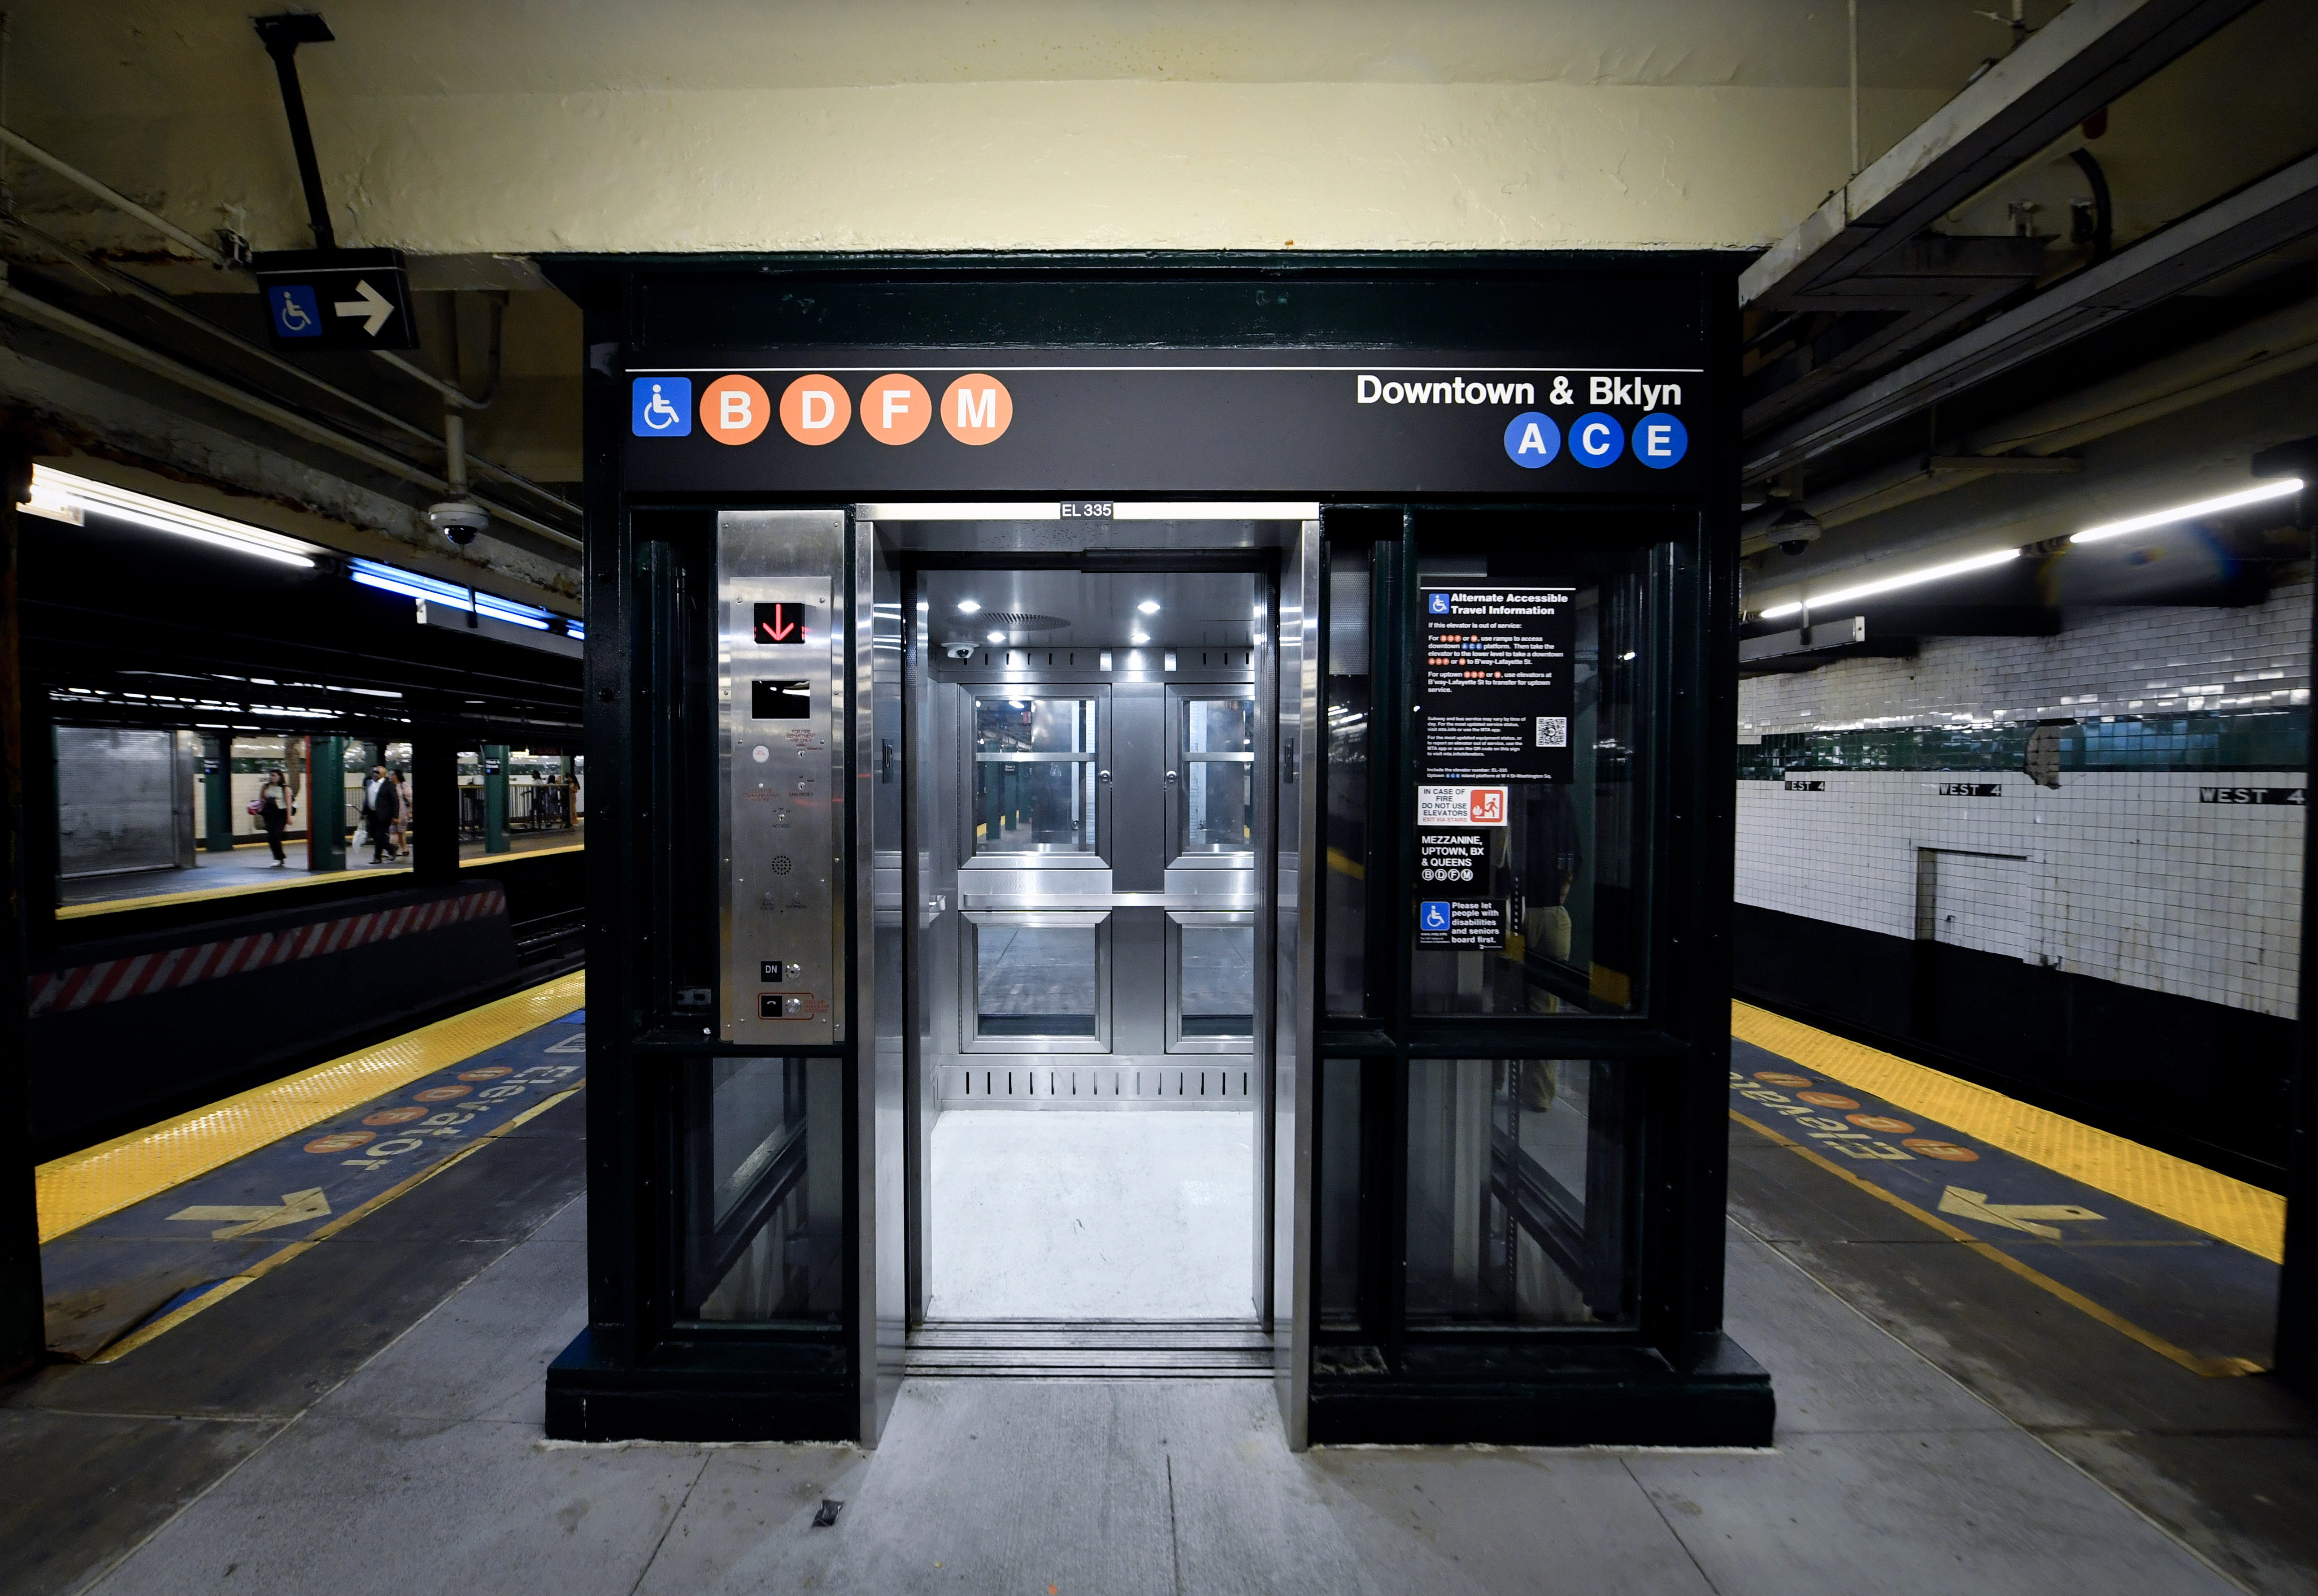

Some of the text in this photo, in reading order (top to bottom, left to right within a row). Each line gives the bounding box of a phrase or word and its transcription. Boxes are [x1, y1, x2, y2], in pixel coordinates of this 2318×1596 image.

[1358, 375, 1681, 411] Downtown & Bklyn
[720, 389, 996, 429] B D F M
[1518, 423, 1672, 456] A C E
[1062, 504, 1112, 517] EL 335
[1451, 593, 1568, 602] Alternate Accessible
[1451, 606, 1554, 614] Travel Information
[1818, 781, 1825, 790] 4
[1940, 785, 2001, 796] WEST 4
[2202, 789, 2305, 804] WEST 4
[1422, 836, 1482, 845] MEZZANINE,
[1422, 847, 1468, 856] UPTOWN,
[1431, 858, 1472, 866] QUEENS
[340, 1065, 580, 1170] Elevator
